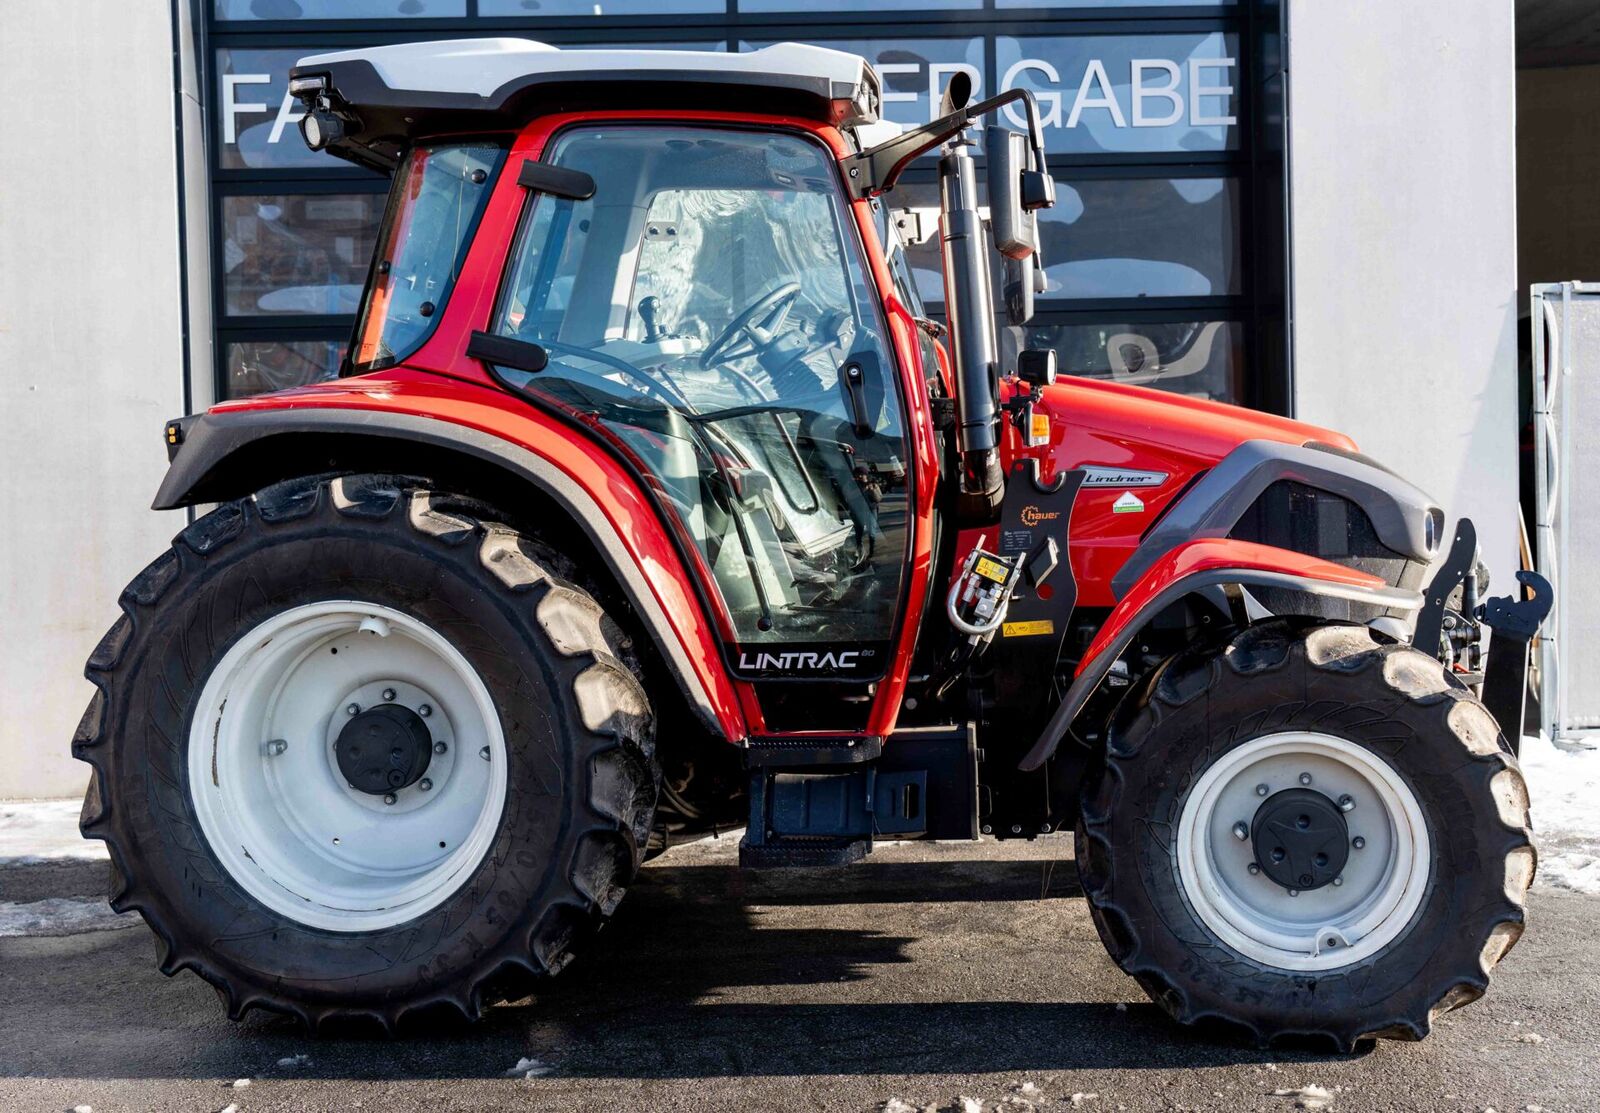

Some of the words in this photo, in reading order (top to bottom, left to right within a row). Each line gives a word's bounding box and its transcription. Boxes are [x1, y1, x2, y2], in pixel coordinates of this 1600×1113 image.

[1085, 474, 1152, 483] Lindner
[1027, 508, 1060, 520] hauer
[739, 651, 859, 669] LINTRAC
